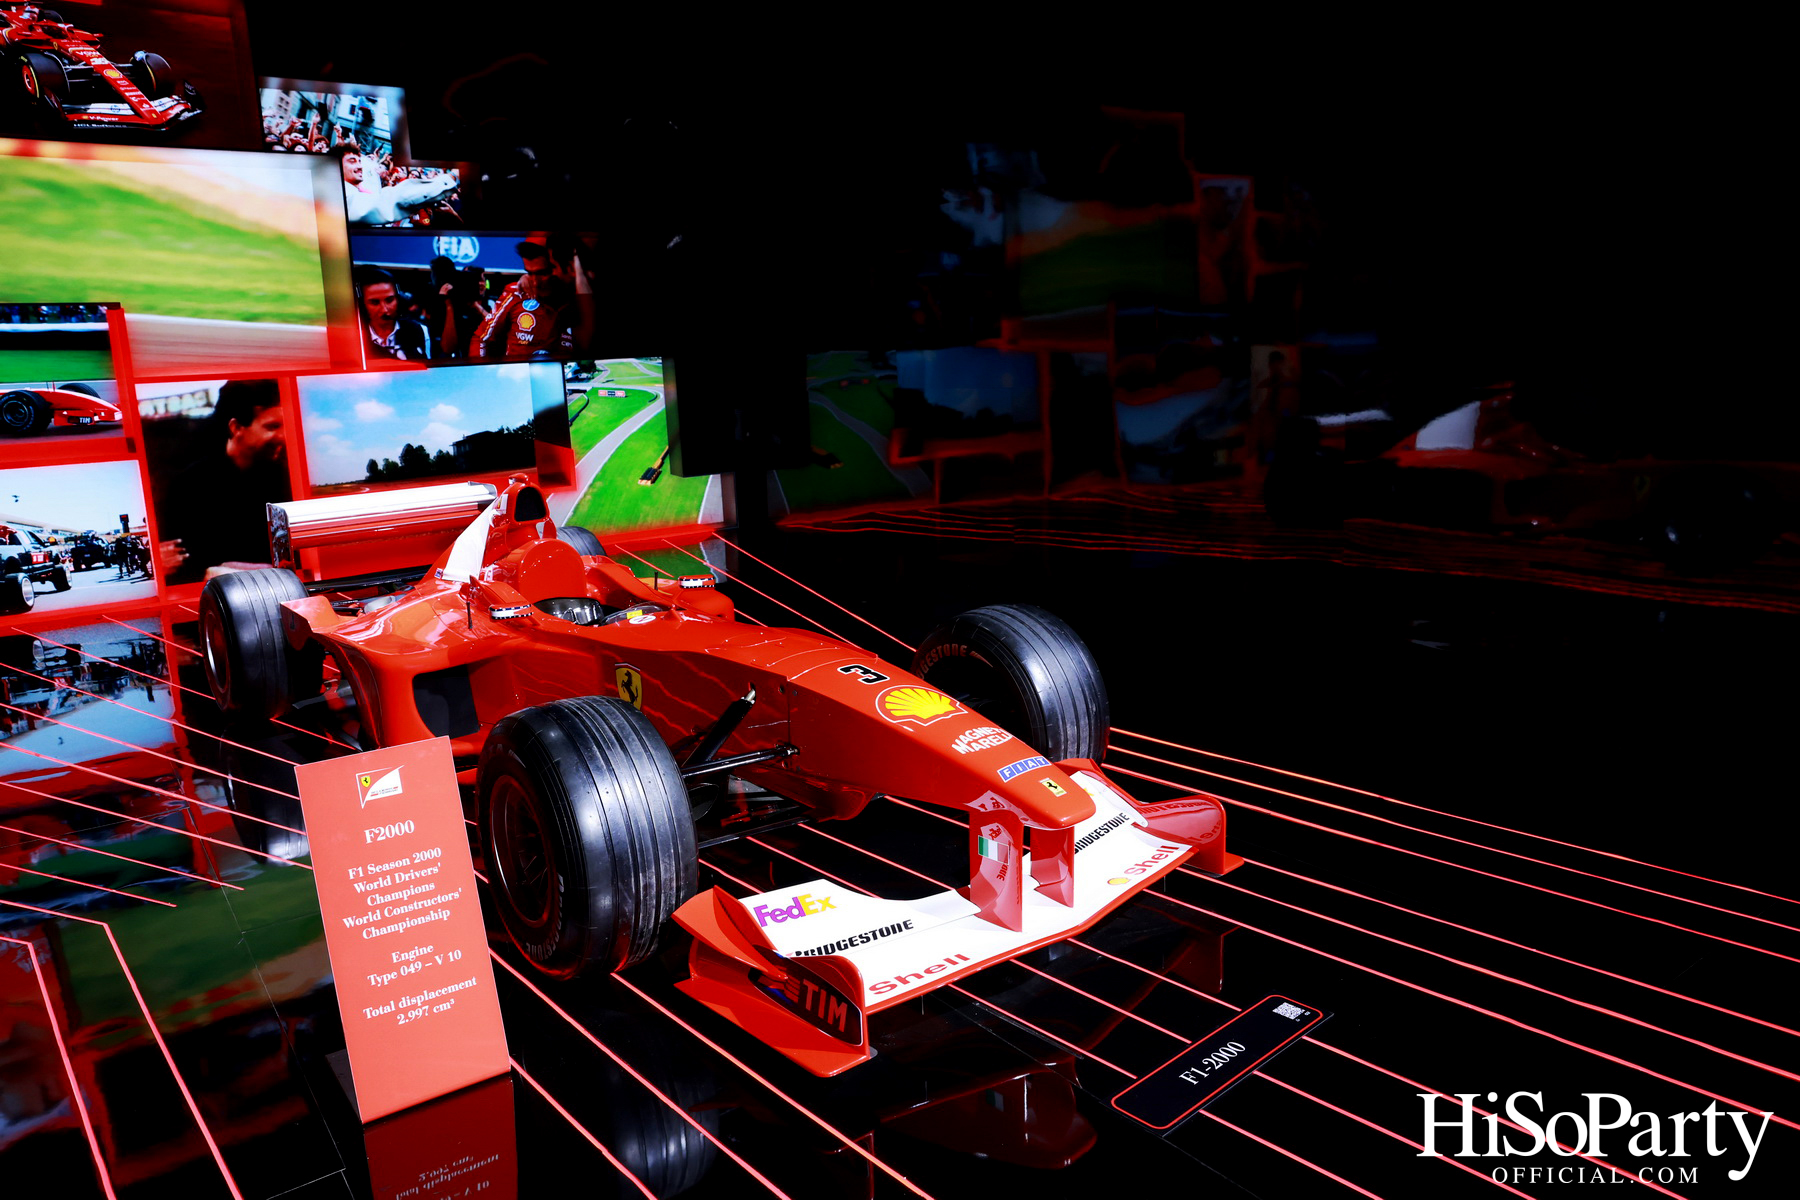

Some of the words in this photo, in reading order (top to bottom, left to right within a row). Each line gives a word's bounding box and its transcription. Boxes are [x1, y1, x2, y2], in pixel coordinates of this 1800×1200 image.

[437, 236, 478, 261] FIA
[837, 664, 890, 685] 3
[999, 756, 1051, 782] FIAT
[364, 819, 415, 844] F2000
[348, 866, 364, 880] F1
[367, 857, 411, 875] Season
[412, 847, 442, 863] 2000
[1123, 845, 1180, 876] Shell
[353, 874, 392, 894] World
[394, 862, 441, 884] Drivers'
[366, 882, 435, 906] Champions
[342, 909, 381, 929] World
[383, 887, 462, 918] Constructors'
[362, 908, 451, 940] Championship
[753, 893, 837, 927] FedEx
[367, 970, 398, 987] Type
[400, 961, 422, 976] 049
[434, 954, 444, 965] V
[447, 949, 462, 963] 10
[391, 945, 434, 963] Engine
[868, 953, 970, 995] Shell
[363, 1000, 396, 1019] Total
[398, 976, 477, 1008] displacement
[803, 978, 848, 1033] TIM
[396, 1005, 429, 1025] 2.997
[1179, 1041, 1246, 1085] F1-2000
